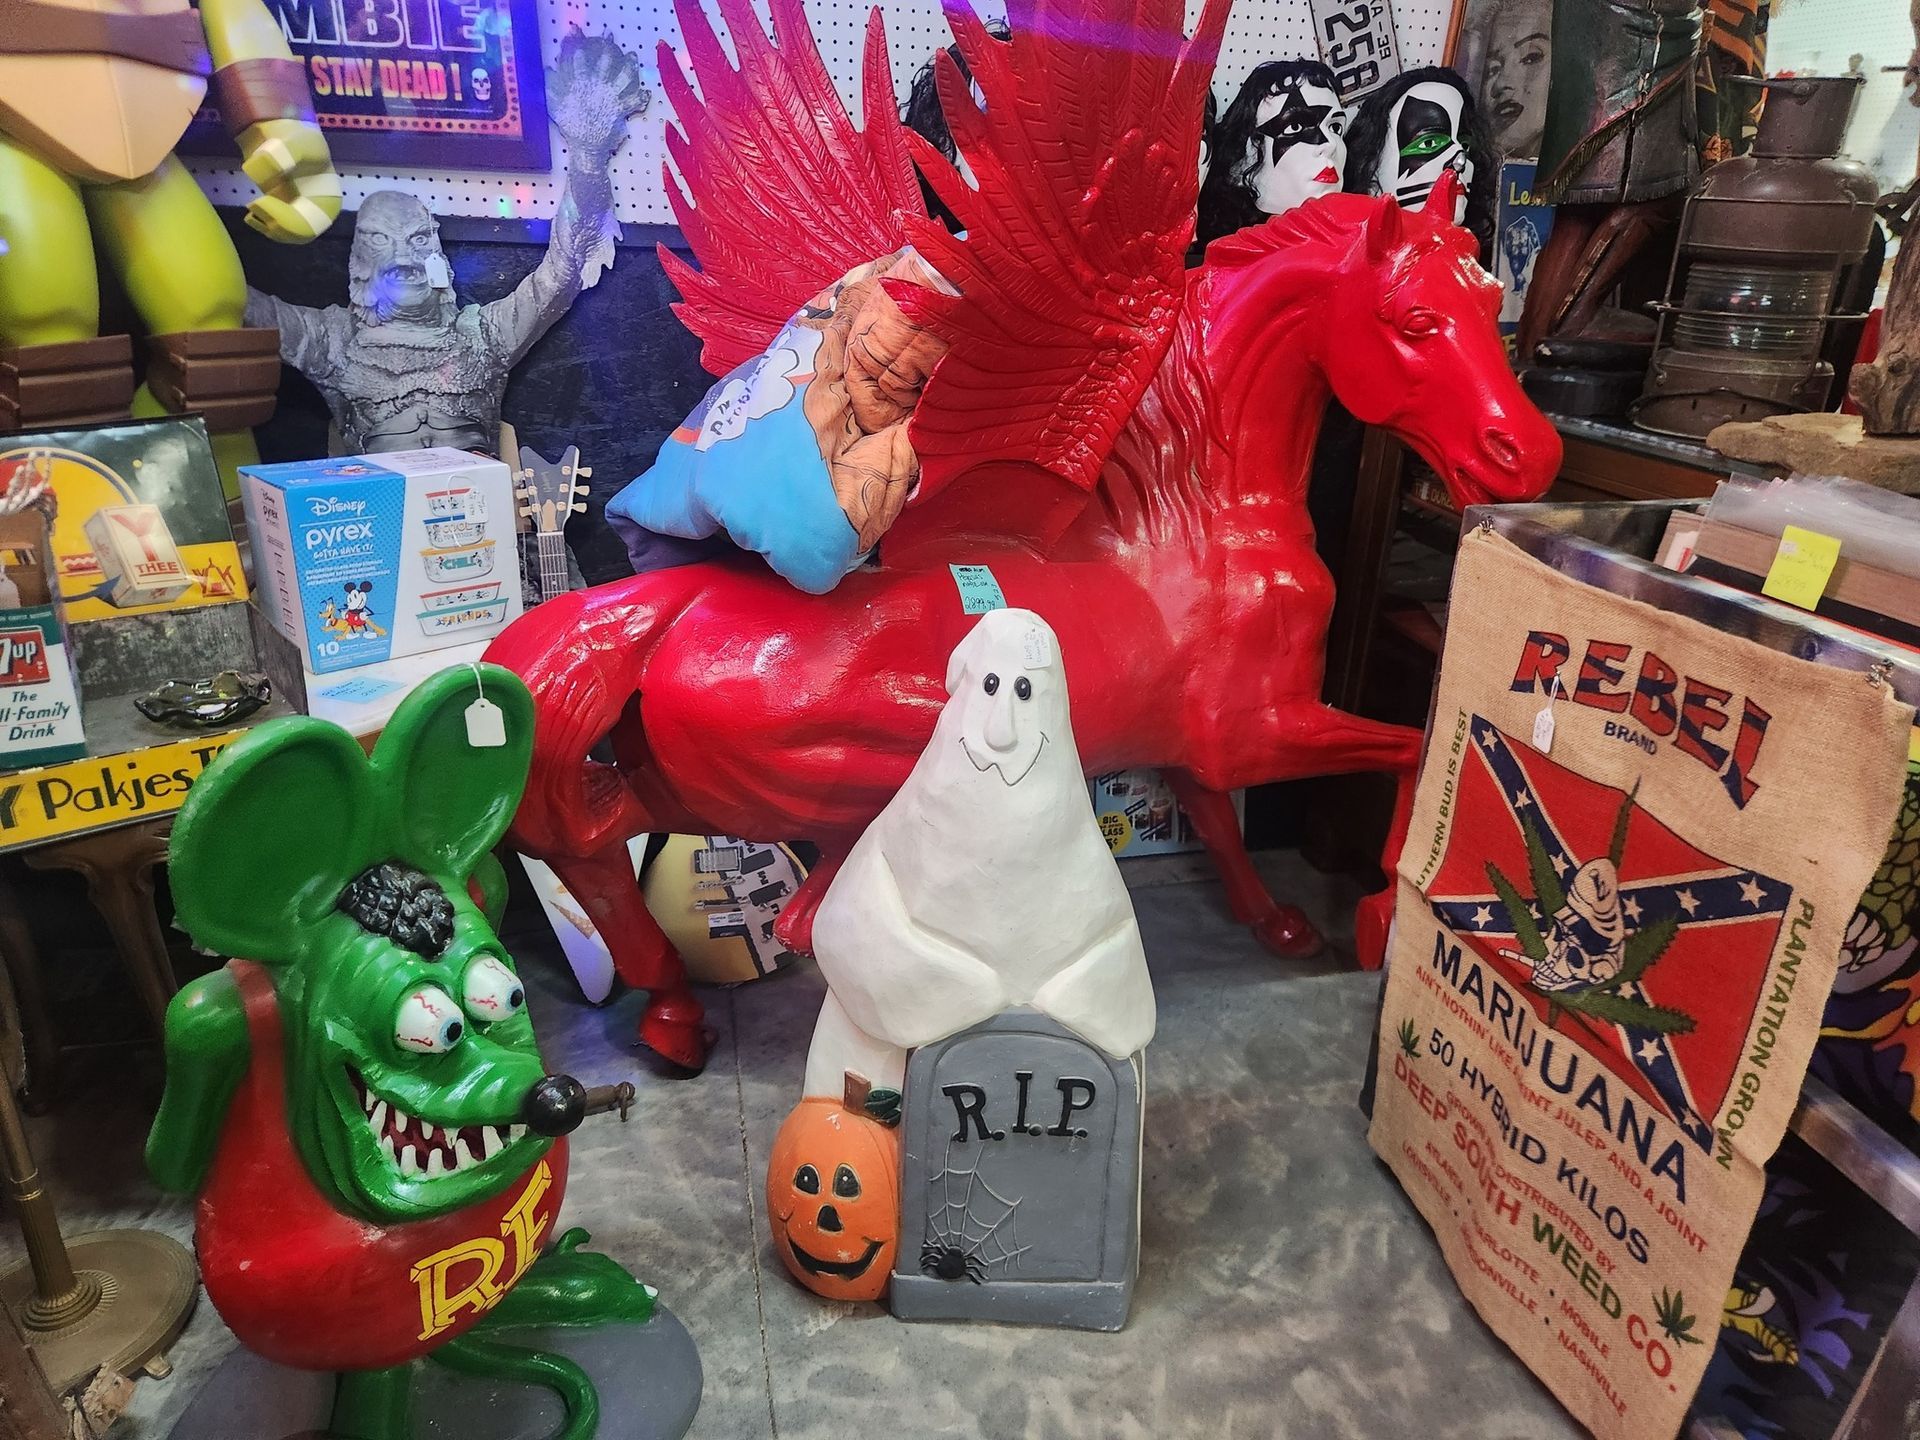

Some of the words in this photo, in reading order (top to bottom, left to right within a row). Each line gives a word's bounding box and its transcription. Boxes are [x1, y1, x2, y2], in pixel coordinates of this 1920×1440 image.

[310, 55, 373, 97] STAY
[378, 59, 447, 101] DEAD
[306, 496, 366, 516] Disney
[306, 522, 375, 550] pyrex
[313, 548, 339, 559] GOTTA
[340, 545, 361, 556] HAVE
[135, 561, 181, 574] THEE
[442, 555, 478, 570] CHILL
[442, 608, 490, 624] FRIENDS
[317, 641, 340, 657] 10
[11, 691, 39, 703] The
[9, 724, 56, 741] Drink
[1451, 707, 1468, 756] BEST
[1508, 630, 1773, 811] REBEL
[1603, 721, 1658, 756] BRAND
[1447, 758, 1458, 777] IS
[37, 762, 195, 820] Pakjes
[1439, 781, 1453, 817] BUD
[1102, 815, 1119, 825] BIG
[1749, 898, 1815, 1069] PLANTATION
[1433, 930, 1686, 1206] MARIJUANA
[1415, 965, 1441, 998] AIN'T
[1442, 993, 1490, 1040] NOTHIN'
[1489, 1036, 1513, 1070] LIKE
[1555, 1108, 1607, 1150] JULEP
[1607, 1151, 1642, 1189] AND
[1643, 1187, 1654, 1206] A
[1656, 1201, 1708, 1253] JOINT
[1716, 1072, 1761, 1171] GROWN
[1429, 1028, 1454, 1067] 50
[1459, 1057, 1547, 1165] HYBRID
[1557, 1157, 1650, 1265] KILOS
[1394, 1053, 1448, 1122] DEEP
[1453, 1121, 1522, 1226] SOUTH
[1533, 1212, 1622, 1319] WEED
[1627, 1314, 1677, 1393] CO.
[1496, 1164, 1594, 1252] DISTRIBUTED
[1595, 1250, 1617, 1274] BY
[410, 1160, 553, 1342] RF
[1560, 1299, 1609, 1360] MOBILE
[1558, 1329, 1627, 1418] NASHVILLE
